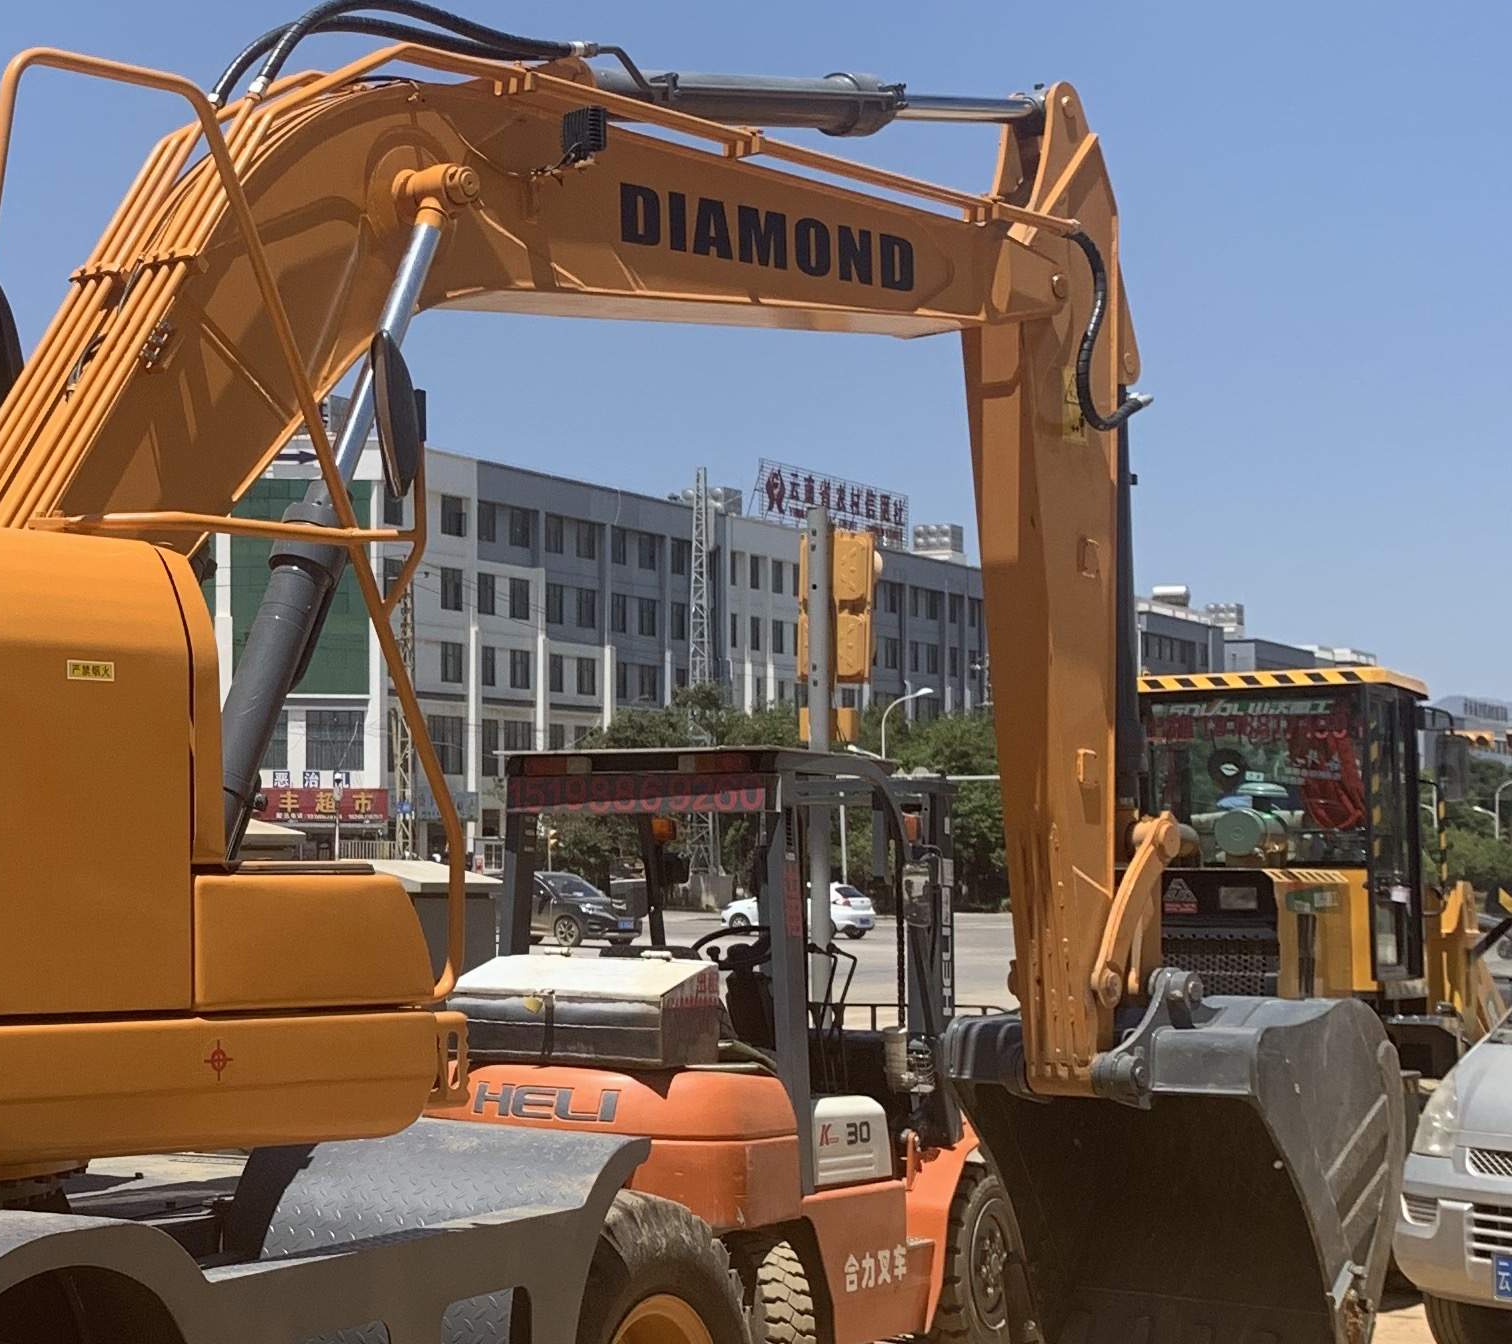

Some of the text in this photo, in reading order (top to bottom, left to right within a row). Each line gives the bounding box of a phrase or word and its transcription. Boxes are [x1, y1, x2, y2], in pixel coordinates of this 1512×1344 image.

[619, 182, 915, 292] DIAMOND
[472, 1080, 621, 1123] HELI
[845, 1120, 872, 1146] 30
[844, 1244, 908, 1292] 合力叉车
